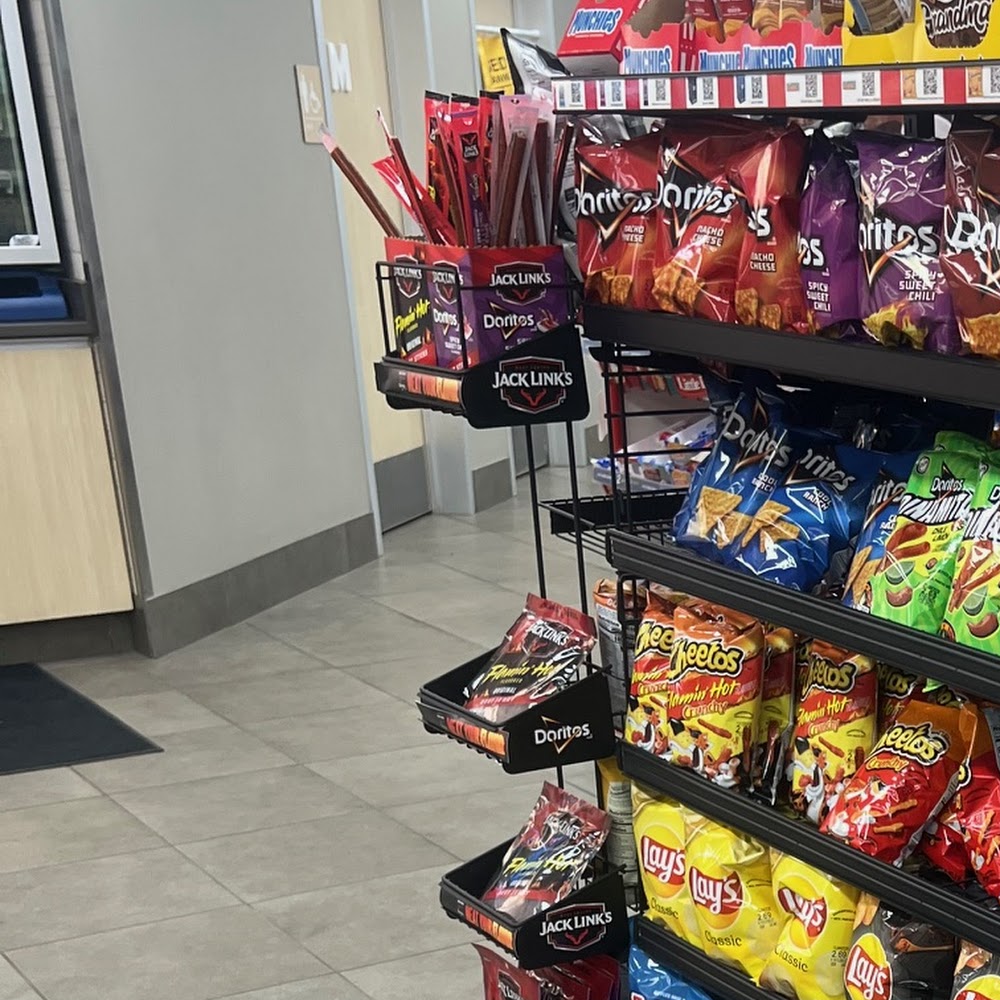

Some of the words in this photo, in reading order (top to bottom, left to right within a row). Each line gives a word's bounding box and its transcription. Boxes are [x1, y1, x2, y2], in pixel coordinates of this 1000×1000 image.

[567, 9, 621, 35] MUNCHIES
[327, 41, 352, 93] M
[743, 45, 796, 69] MUNCHIES
[490, 272, 517, 287] JACK
[519, 271, 551, 285] LINK'S
[808, 281, 829, 292] SPICY
[908, 290, 936, 302] CHILI
[433, 308, 458, 326] Doritos
[813, 301, 831, 313] CHILI
[484, 313, 534, 330] Doritos
[492, 372, 530, 389] JACK
[530, 370, 573, 388] LINK'S
[931, 477, 964, 492] Doritos
[709, 678, 740, 699] Hot
[826, 696, 848, 715] Hot
[534, 722, 591, 746] Doritos
[643, 836, 686, 882] Lay's
[690, 867, 741, 915] Lay's
[650, 897, 680, 921] Classic
[540, 918, 574, 936] JACK
[573, 911, 613, 930] LINK'S
[705, 929, 743, 948] Classic
[773, 945, 809, 973] Classic
[846, 945, 888, 1000] Lay's
